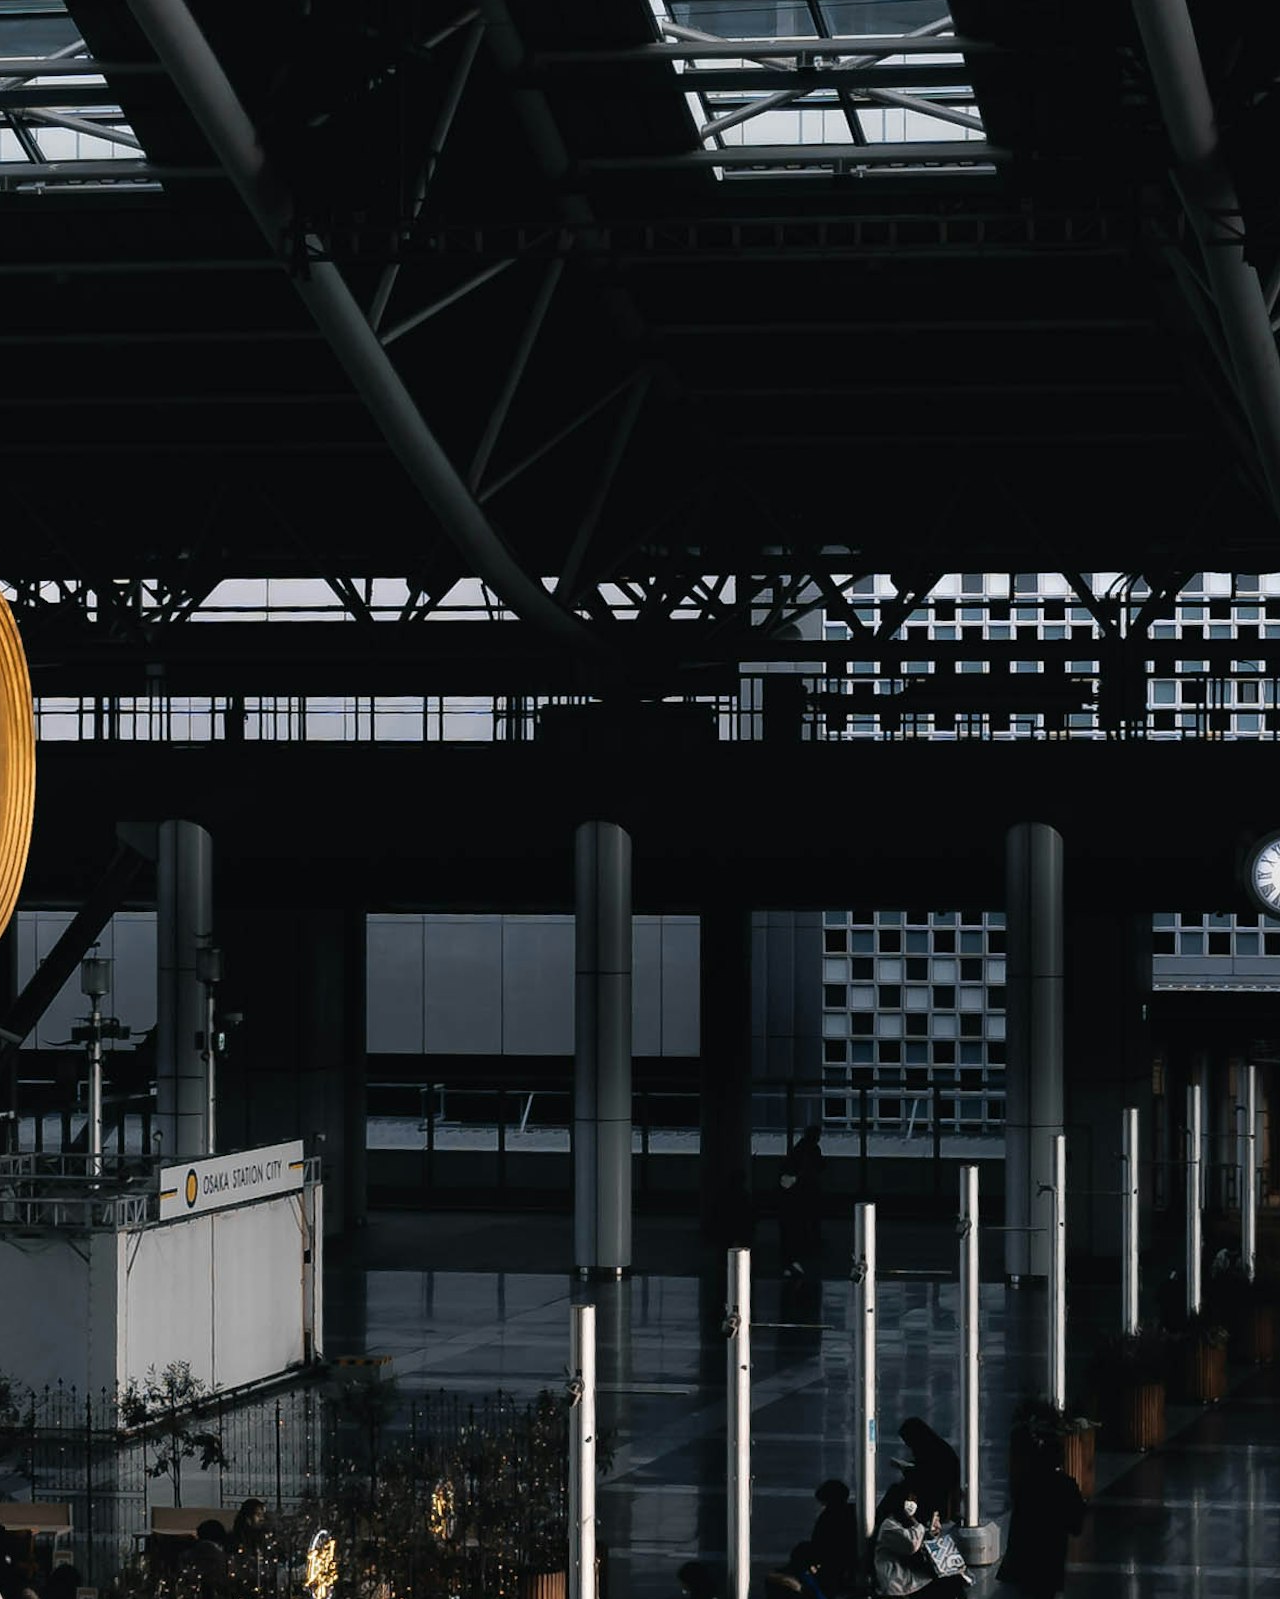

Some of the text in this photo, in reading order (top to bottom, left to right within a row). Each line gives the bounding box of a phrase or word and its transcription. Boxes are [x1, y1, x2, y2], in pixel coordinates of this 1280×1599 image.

[203, 1159, 283, 1195] OSAKA STATION CITY
